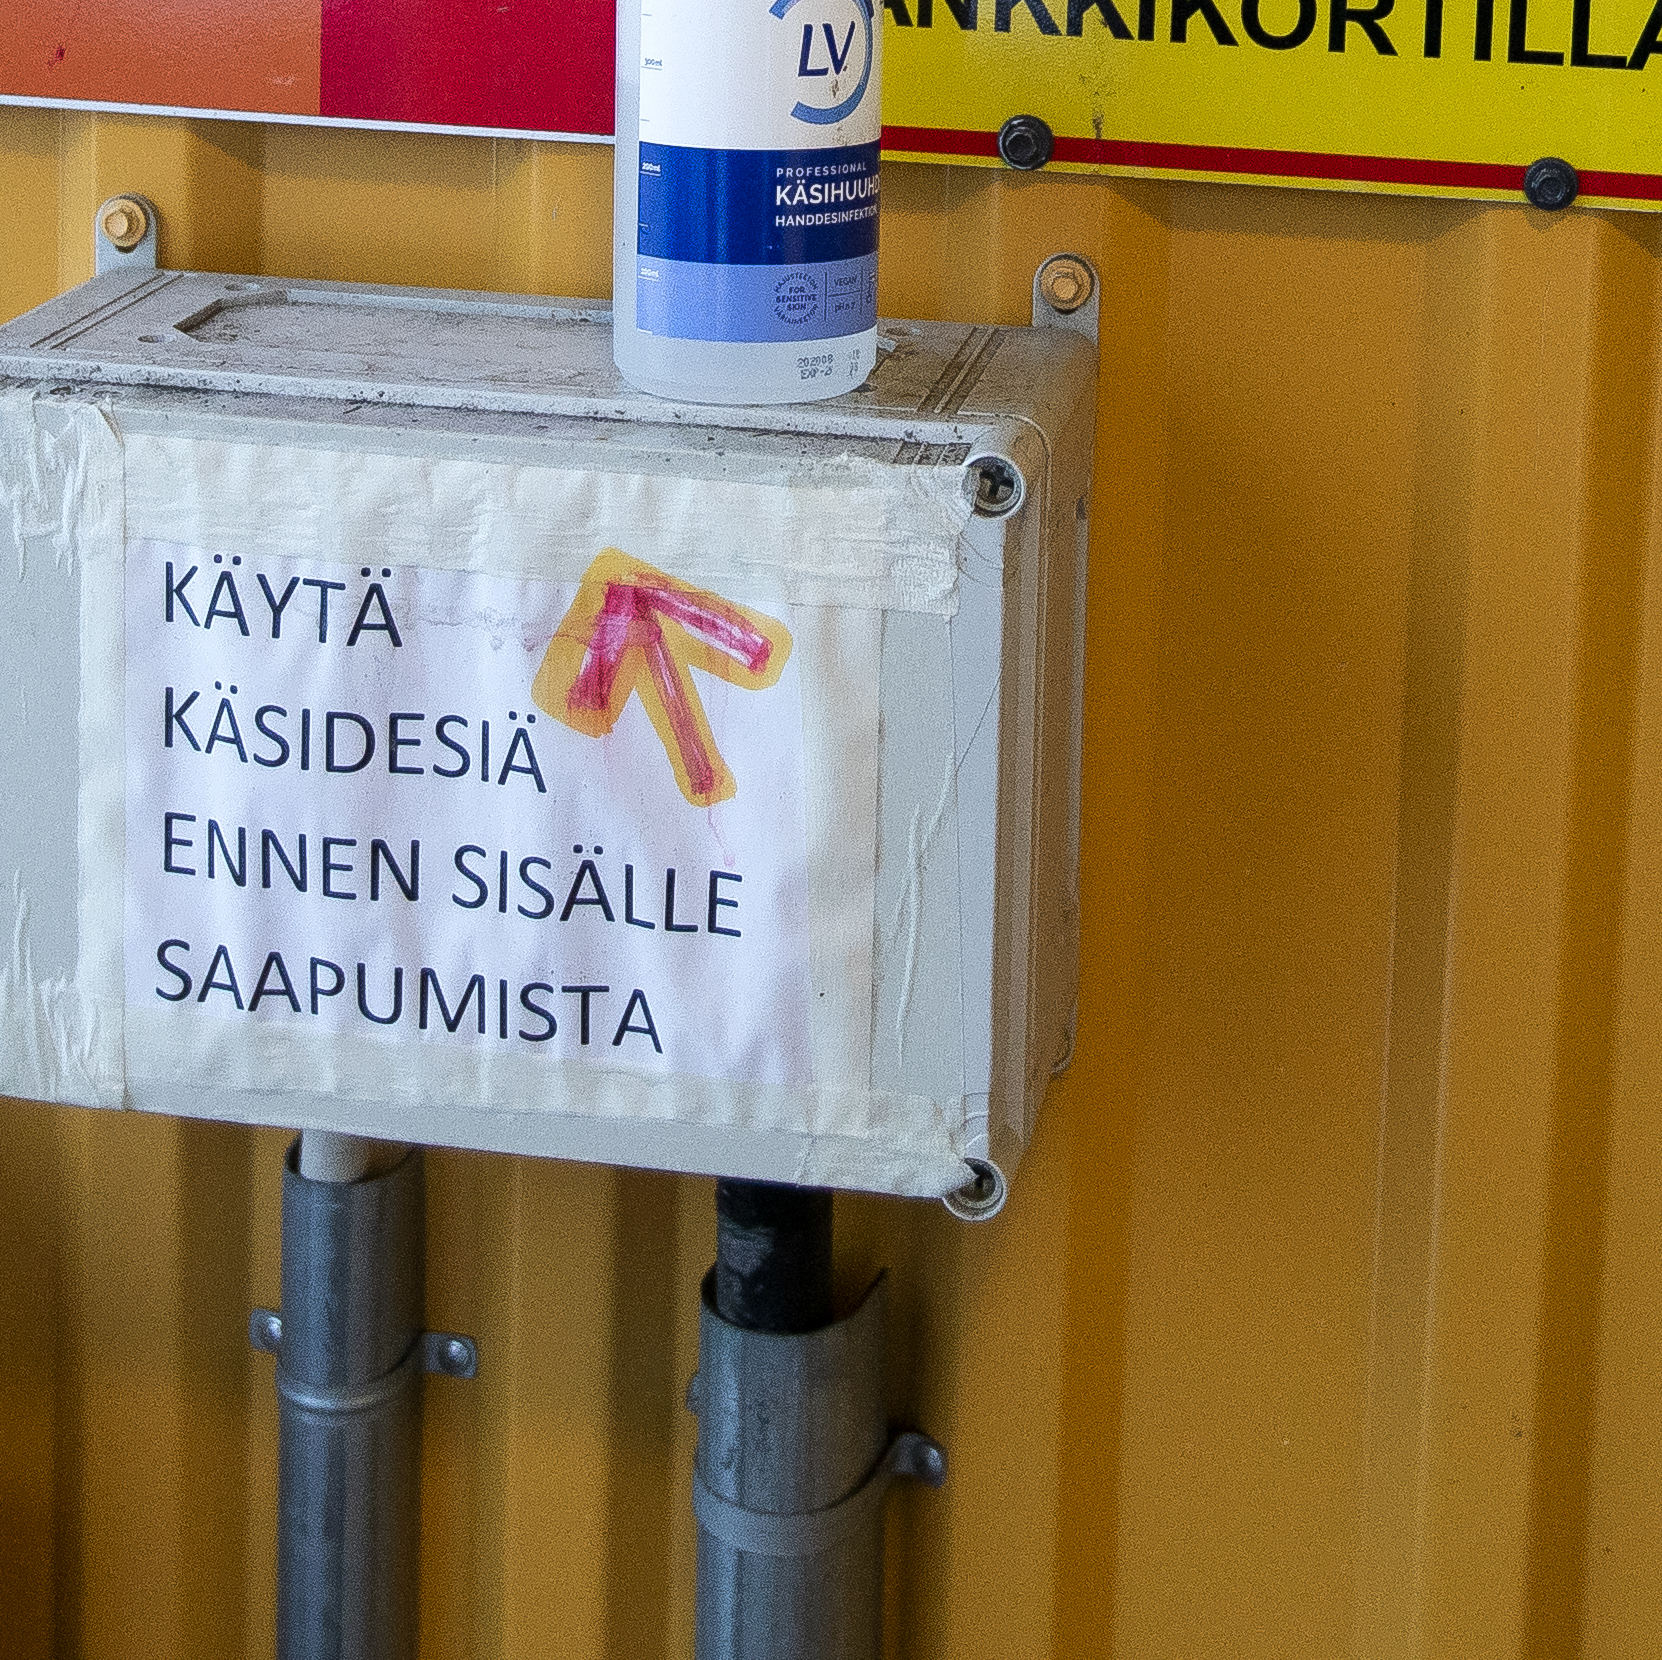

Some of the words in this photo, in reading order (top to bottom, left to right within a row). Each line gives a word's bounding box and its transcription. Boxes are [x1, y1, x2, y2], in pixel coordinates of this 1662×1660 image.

[798, 20, 856, 77] LV
[776, 162, 867, 178] PROFESSIONAL
[775, 293, 817, 303] SENSITIVE
[788, 285, 806, 294] FOR
[164, 554, 404, 649] KÄYTÄ
[163, 683, 548, 794] KÄSIDESIÄ
[162, 811, 421, 903] ENNEN
[451, 843, 744, 939] SISÄLLE
[155, 939, 664, 1054] SAAPUMISTA
